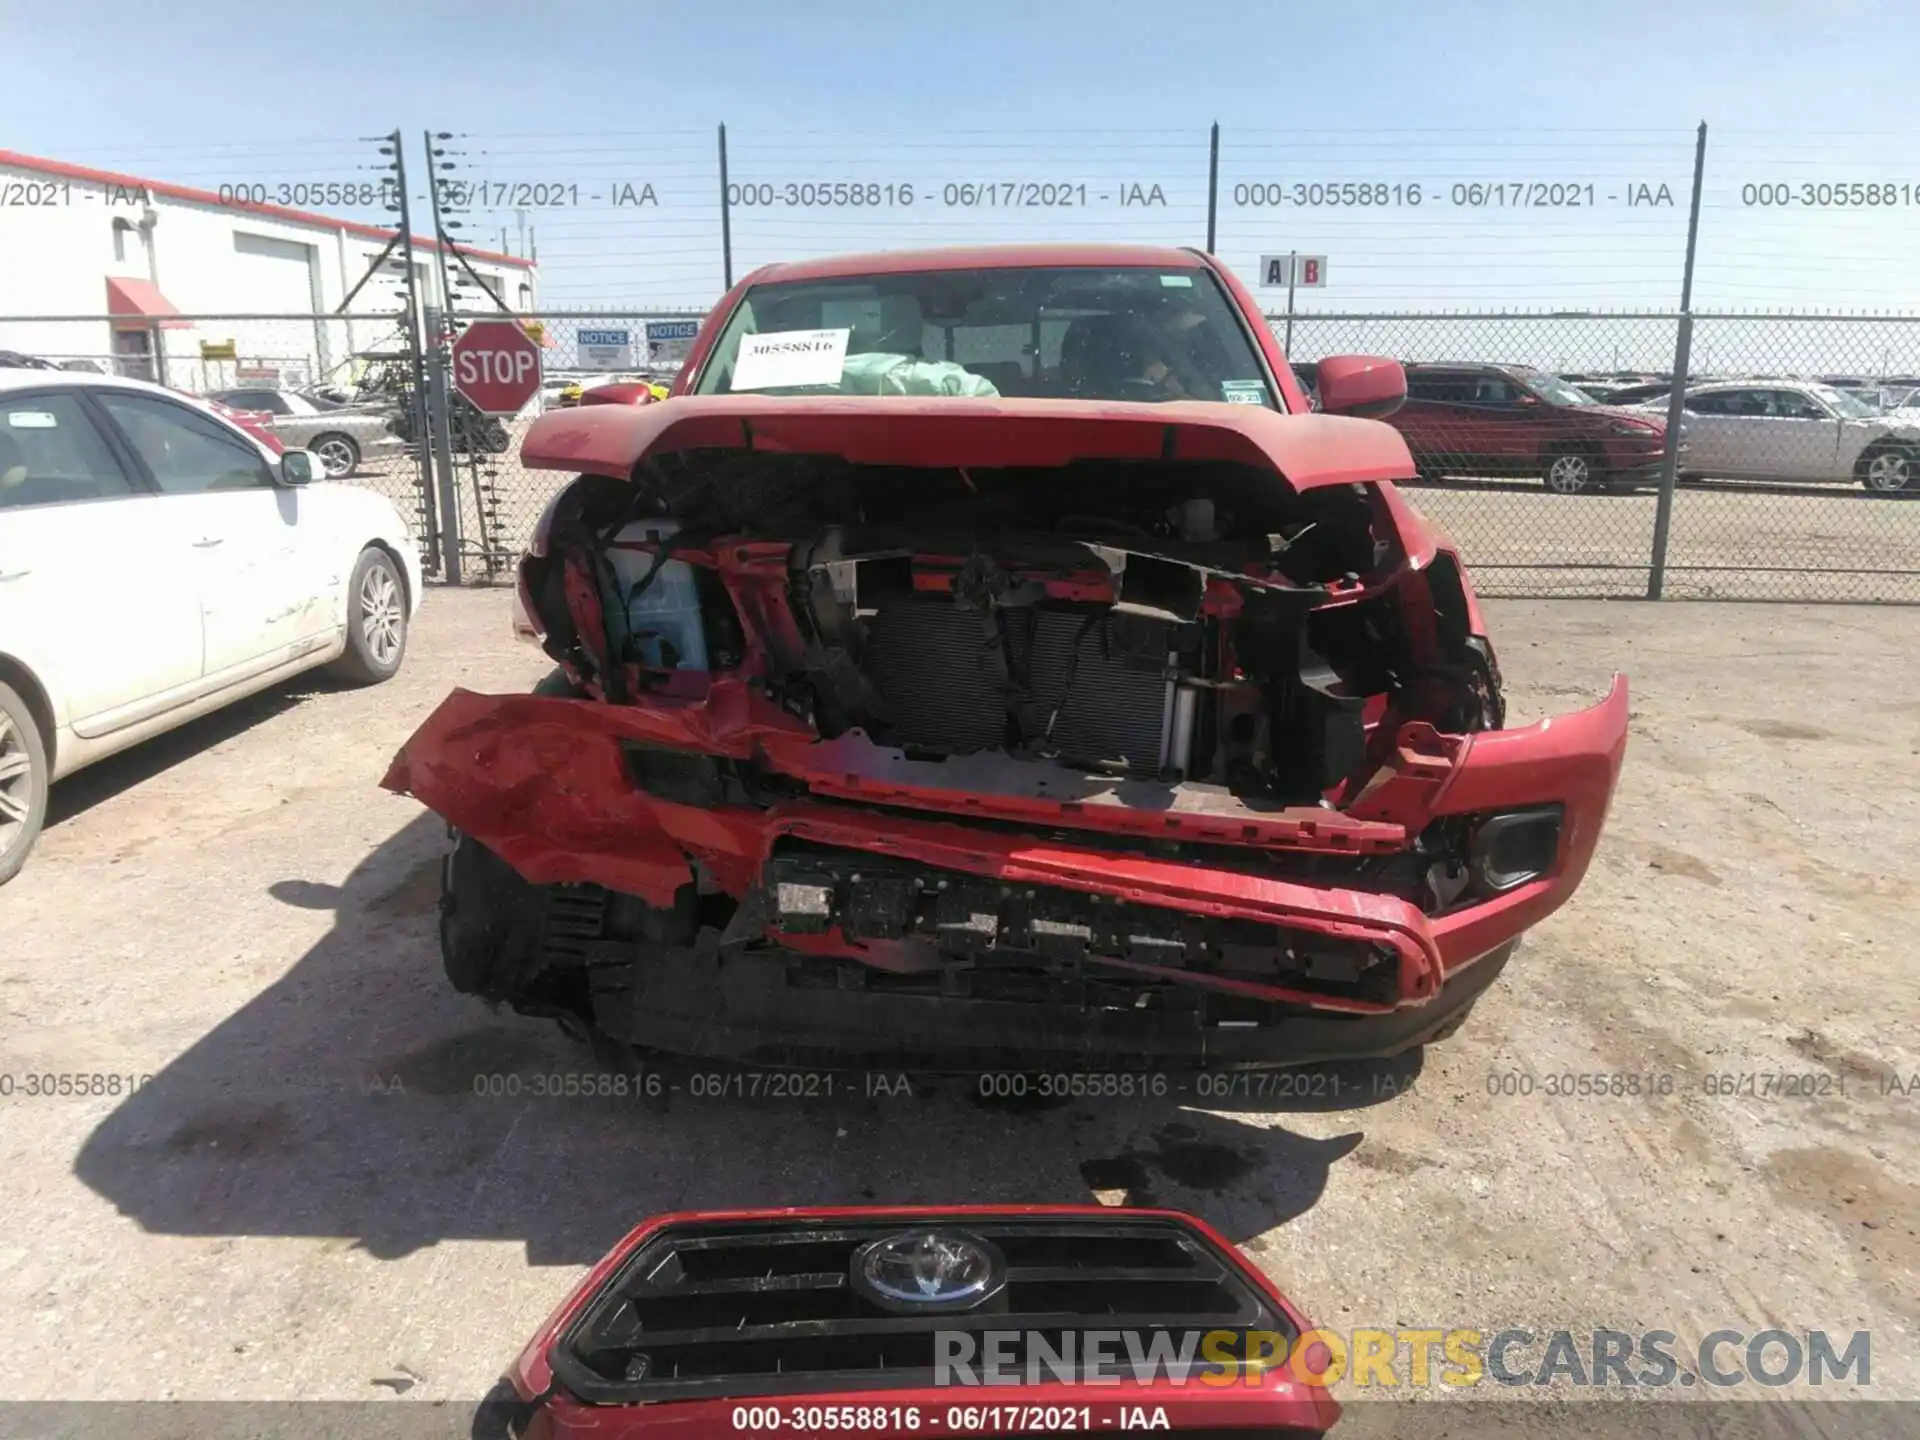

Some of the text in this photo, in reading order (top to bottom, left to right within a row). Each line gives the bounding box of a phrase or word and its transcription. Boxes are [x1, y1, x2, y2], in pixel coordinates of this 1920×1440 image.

[1266, 259, 1282, 284] A
[1304, 259, 1319, 284] B
[579, 331, 626, 345] NOTICE
[649, 323, 695, 338] NOTICE
[459, 349, 535, 385] STOP
